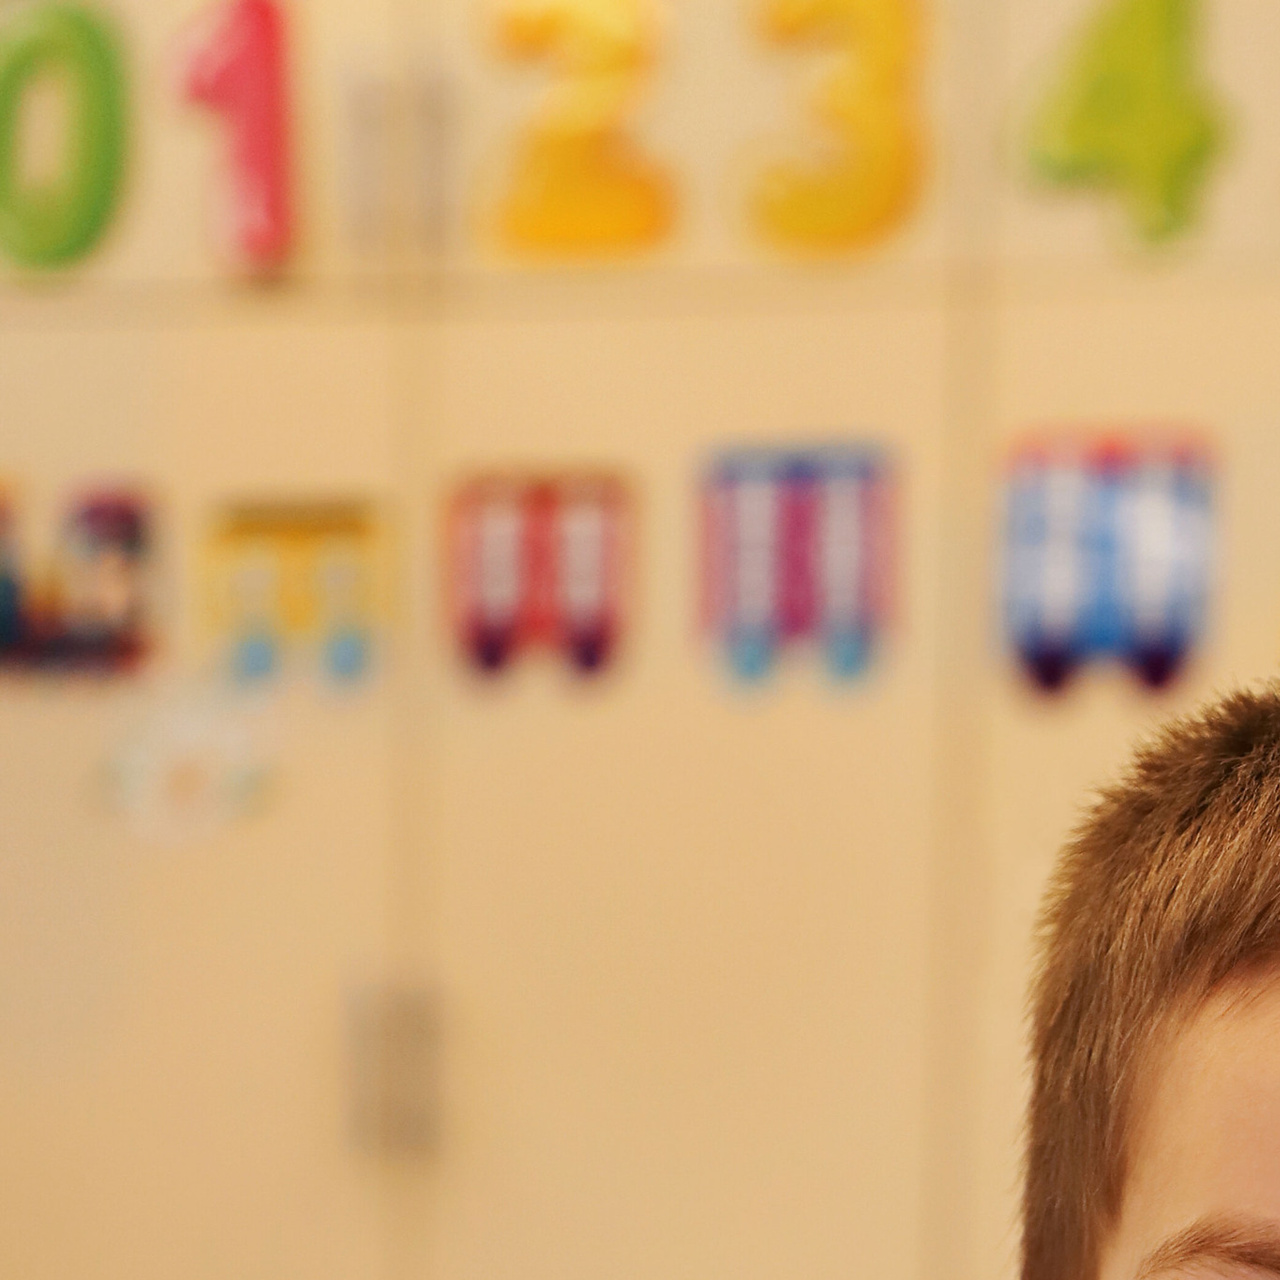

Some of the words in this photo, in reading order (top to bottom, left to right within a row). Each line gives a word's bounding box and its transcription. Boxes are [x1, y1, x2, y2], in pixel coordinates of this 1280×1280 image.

[176, 0, 297, 290] 1
[488, 0, 678, 262] 2
[748, 0, 930, 252] 3
[1030, 0, 1230, 248] 4
